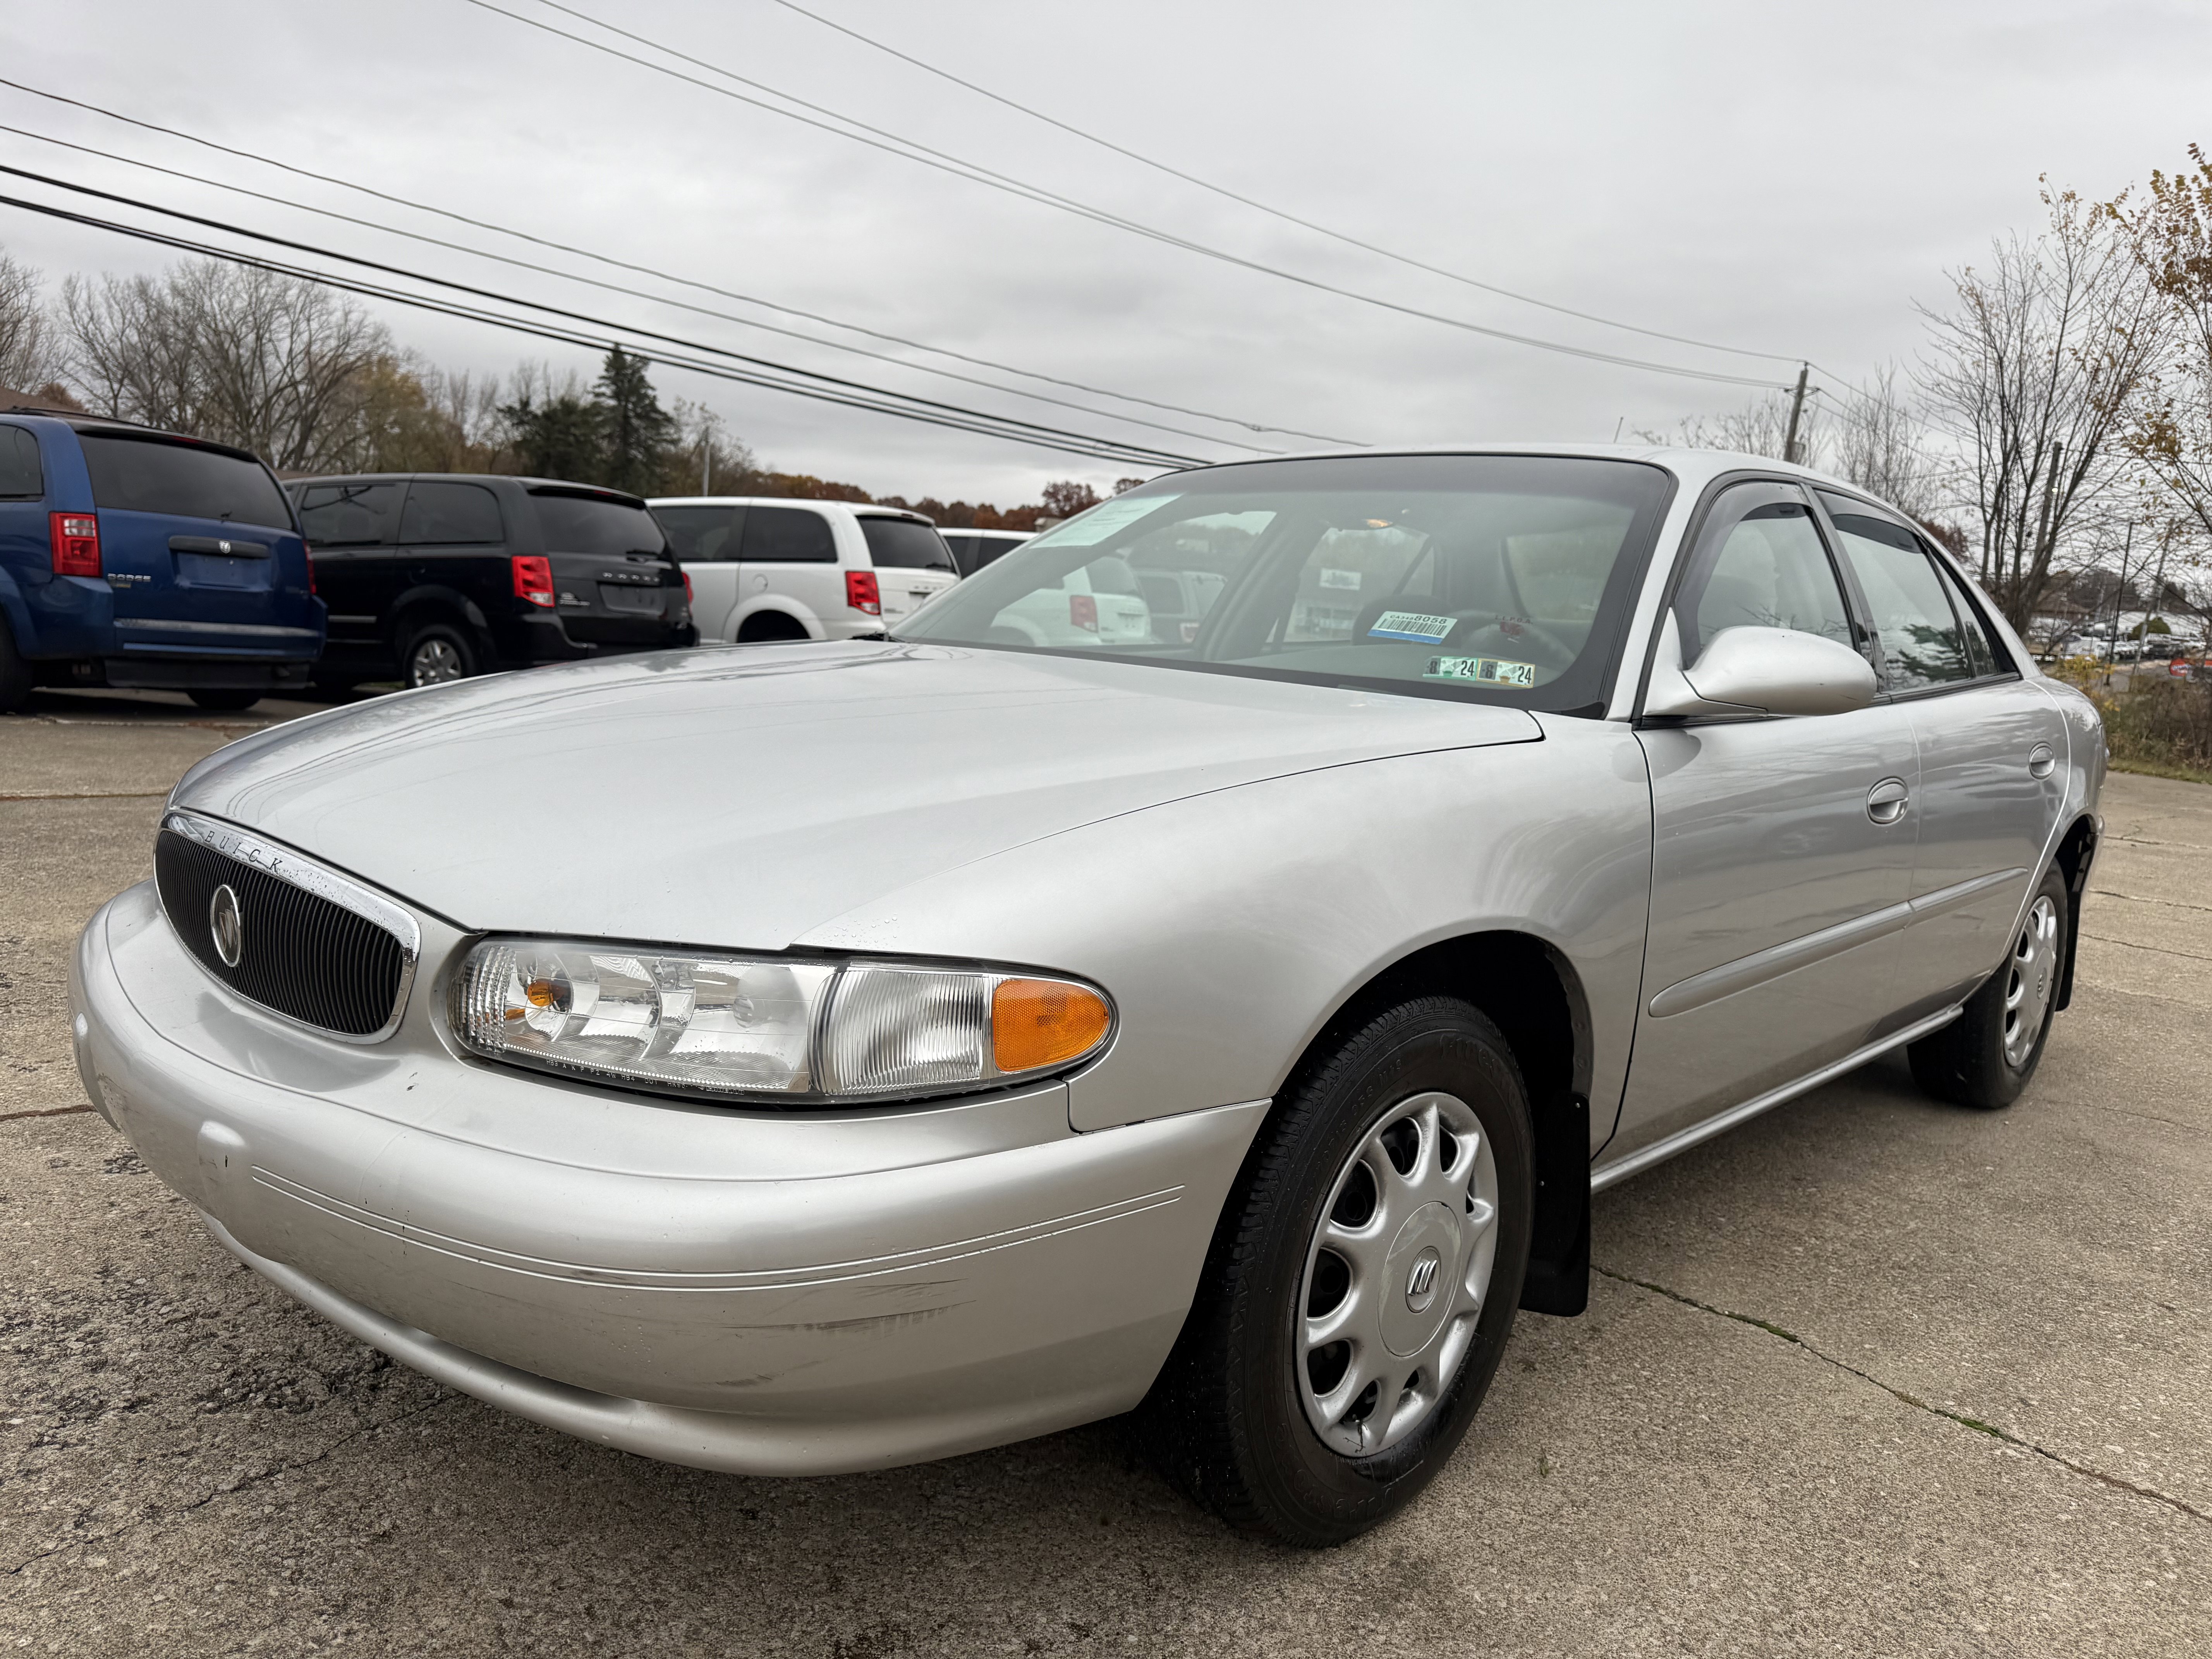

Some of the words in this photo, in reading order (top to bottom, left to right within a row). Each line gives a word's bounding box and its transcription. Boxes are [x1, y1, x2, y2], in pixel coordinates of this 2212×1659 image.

[107, 573, 151, 582] DODGE
[1460, 660, 1475, 676] 24
[1517, 666, 1532, 684] 24
[205, 831, 283, 873] BUICK
